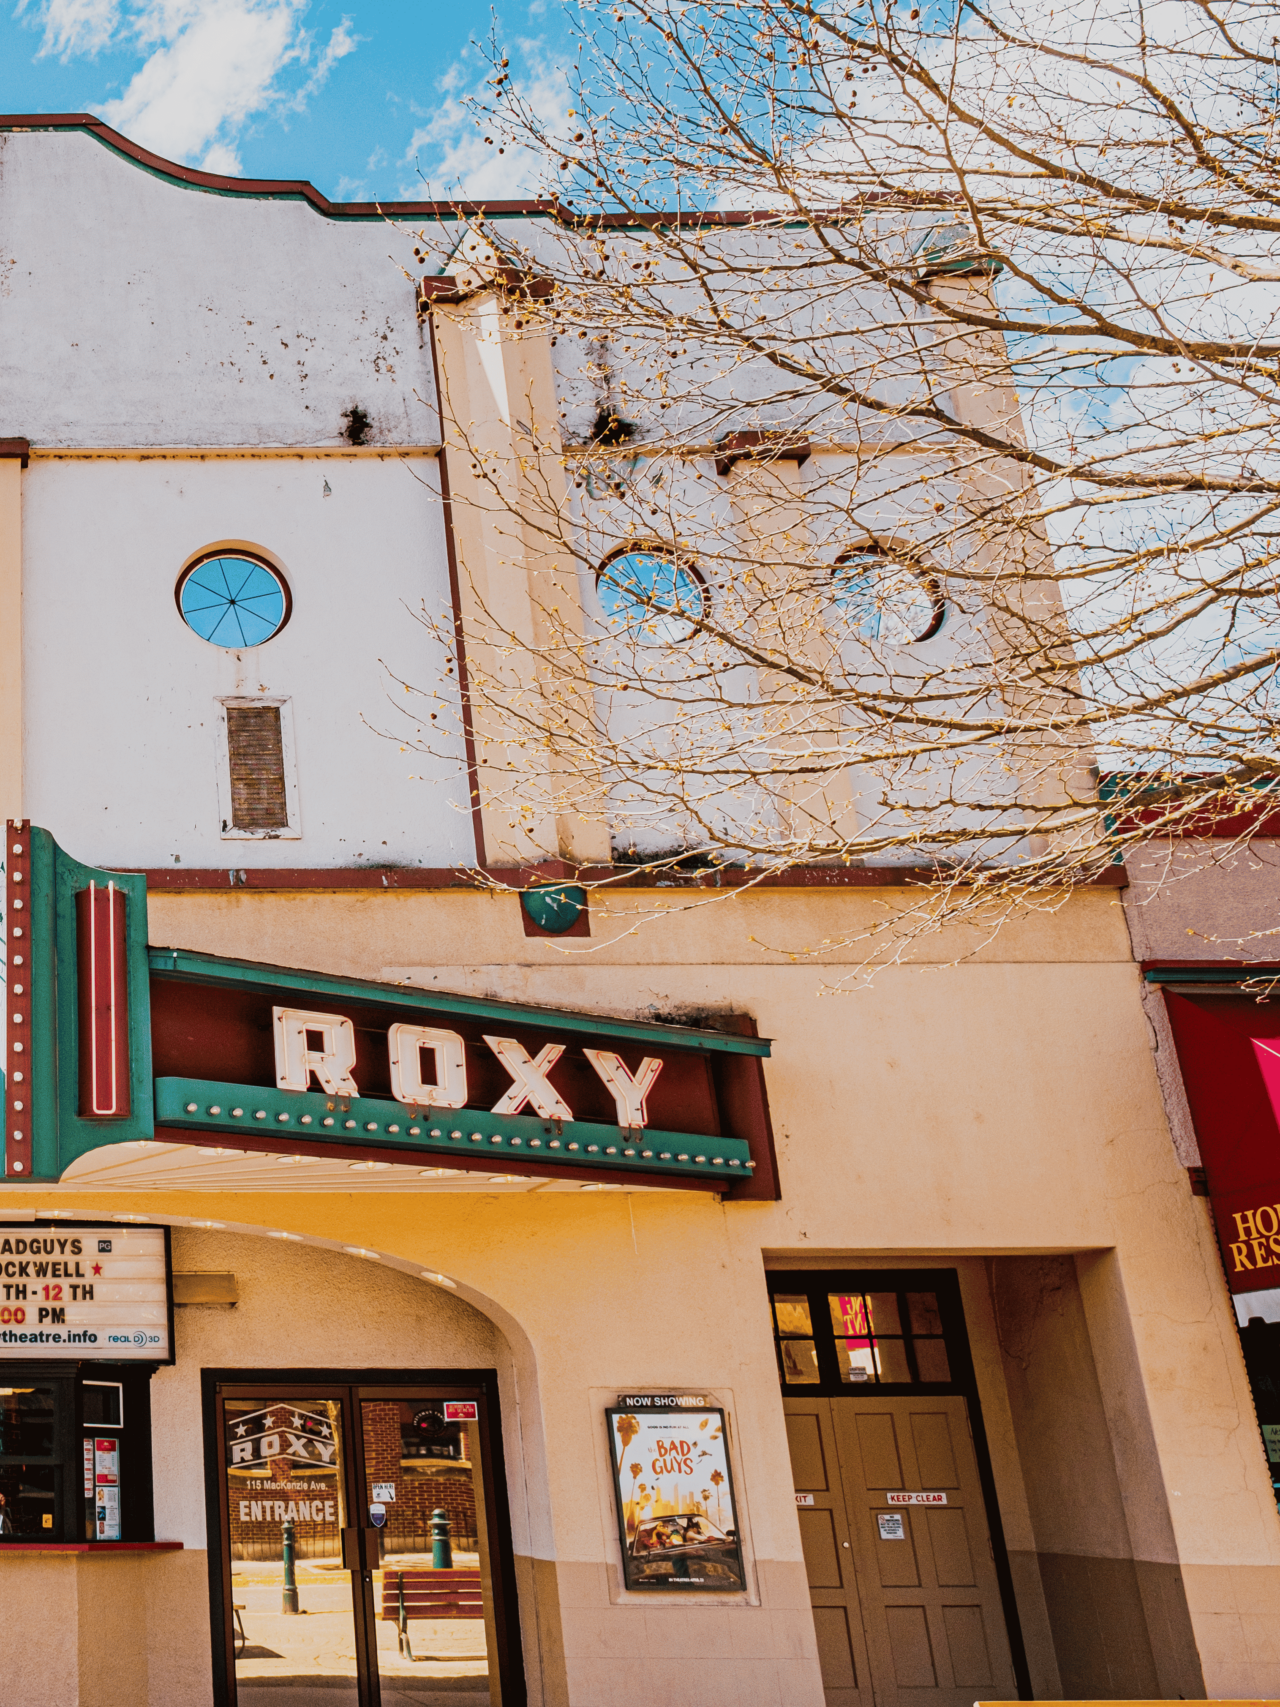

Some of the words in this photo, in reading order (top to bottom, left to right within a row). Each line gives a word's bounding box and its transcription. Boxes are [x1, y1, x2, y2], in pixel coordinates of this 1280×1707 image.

[271, 1005, 664, 1129] ROXY
[1232, 1203, 1280, 1241] HO
[98, 1242, 112, 1251] PG
[2, 1283, 27, 1301] TH
[42, 1283, 63, 1301] 12
[69, 1283, 94, 1301] TH
[37, 1306, 66, 1324] PM
[626, 1397, 651, 1406] NOW
[654, 1397, 705, 1406] SHOWING
[232, 1433, 336, 1463] ROXY
[656, 1440, 691, 1458] BAD
[651, 1456, 694, 1476] GUYS
[246, 1480, 261, 1489] 115
[263, 1480, 308, 1490] MacKenzie
[310, 1480, 328, 1490] Ave.
[890, 1494, 913, 1503] KEEP
[915, 1494, 943, 1503] CLEAR
[239, 1500, 335, 1521] ENTRANCE
